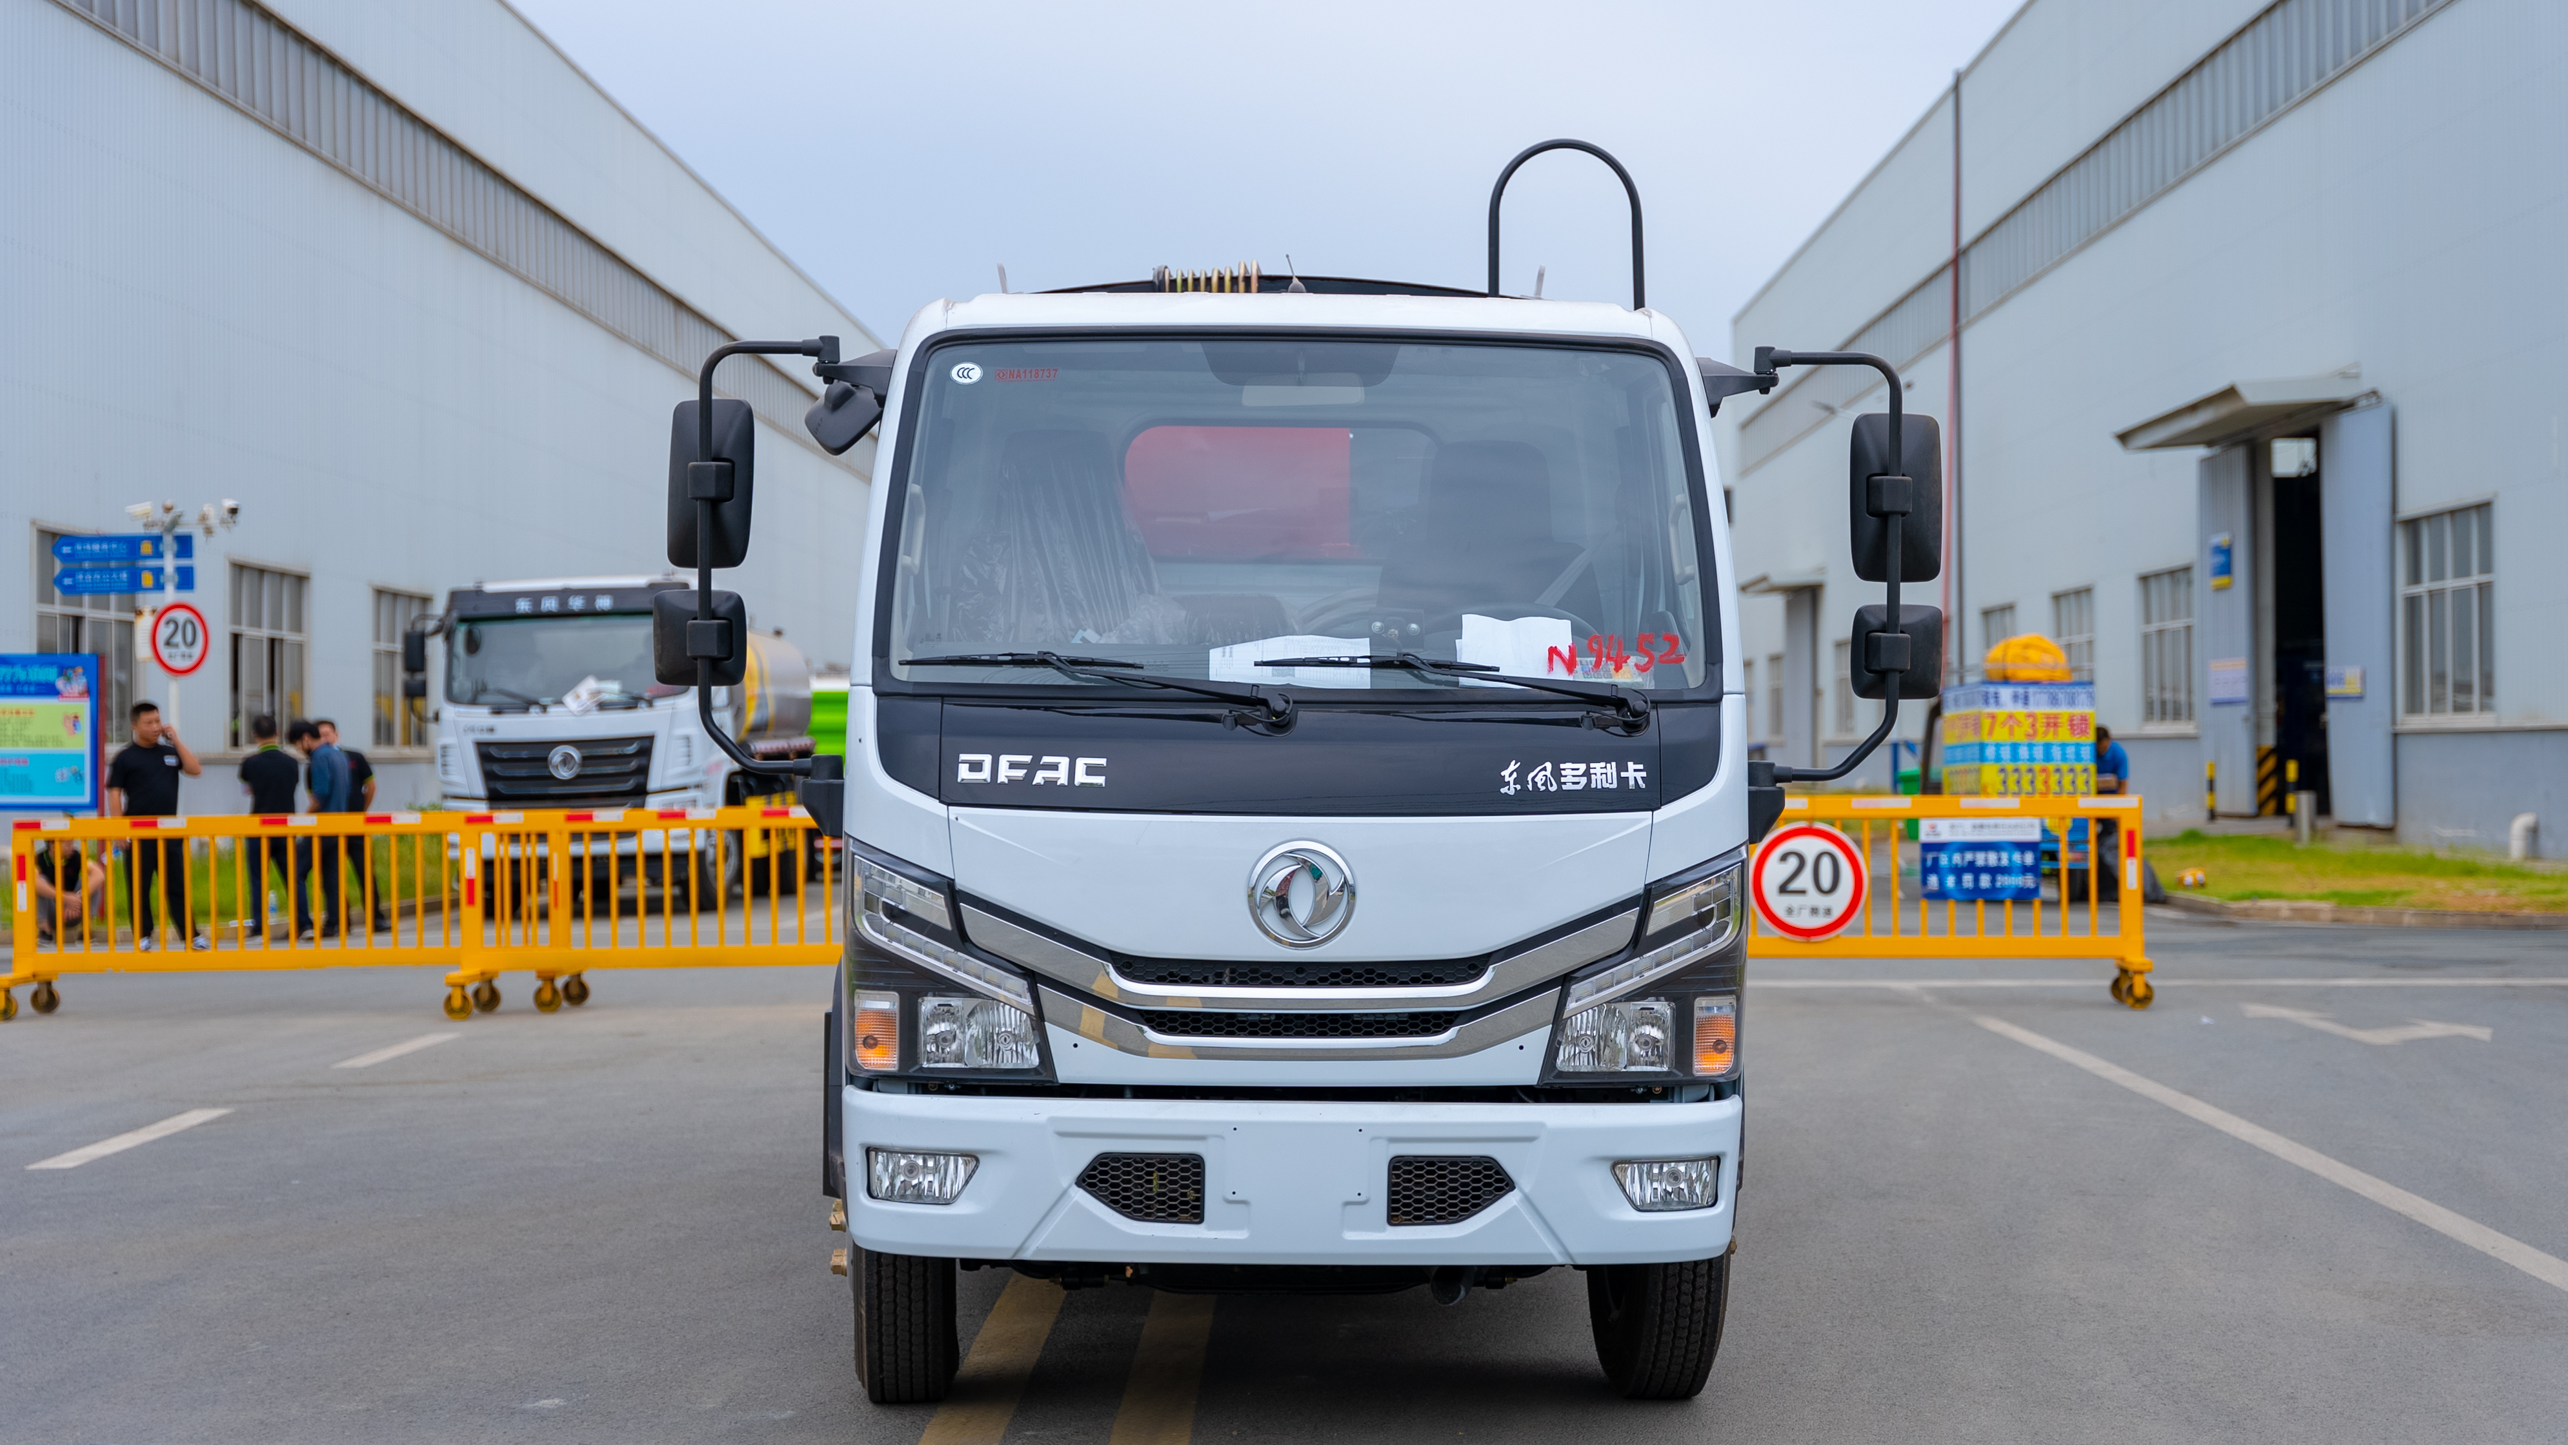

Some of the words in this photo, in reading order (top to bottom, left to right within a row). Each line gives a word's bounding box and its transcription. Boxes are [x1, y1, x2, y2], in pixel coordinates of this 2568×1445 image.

[1008, 368, 1058, 379] NA118737
[164, 618, 197, 648] 20
[1984, 711, 2091, 740] 7个3开锁
[957, 753, 1107, 787] DFAC
[1500, 759, 1647, 795] 东风多利卡
[1778, 851, 1841, 895] 20
